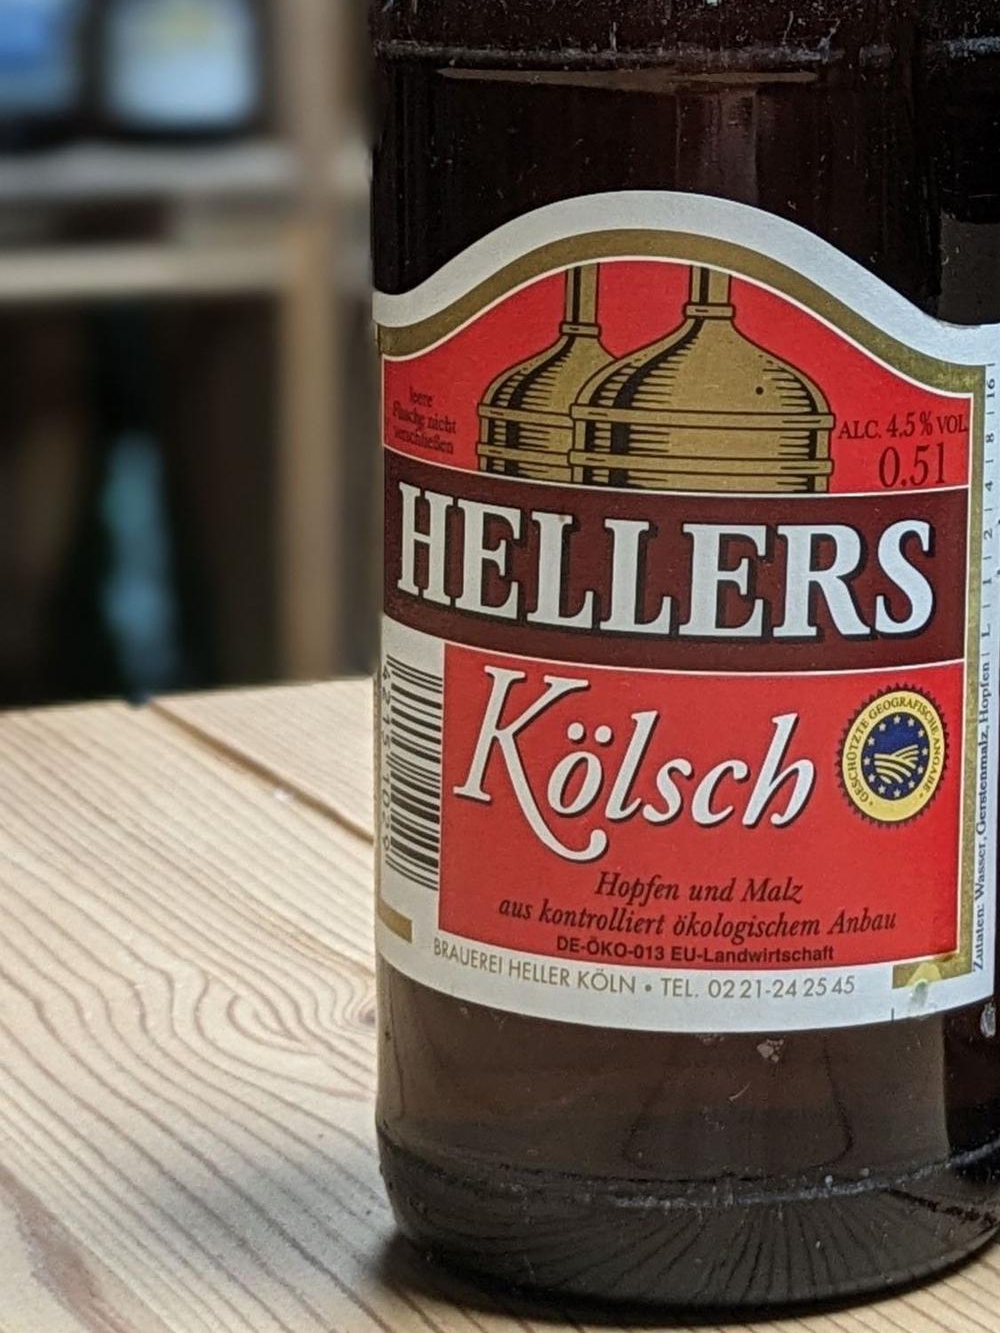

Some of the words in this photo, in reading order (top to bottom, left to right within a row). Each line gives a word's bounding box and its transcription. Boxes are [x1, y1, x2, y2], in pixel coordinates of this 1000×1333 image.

[838, 420, 883, 440] ALC.
[397, 481, 934, 637] HELLERS
[452, 666, 816, 862] Kölsch
[595, 871, 679, 907] Hopfen
[688, 878, 736, 903] und
[741, 876, 804, 905] Malz
[498, 898, 533, 920] aus
[538, 898, 665, 936] kontrolliert
[673, 913, 821, 945] ökologischem
[827, 908, 896, 936] Anbau
[433, 937, 502, 974] BRAUEREI
[508, 958, 571, 988] HELLER
[577, 968, 636, 994] KÖLN
[660, 978, 699, 998] TEL.
[556, 936, 665, 961] DE-ÖKO-013
[671, 945, 834, 964] EU-Landwirtschaft
